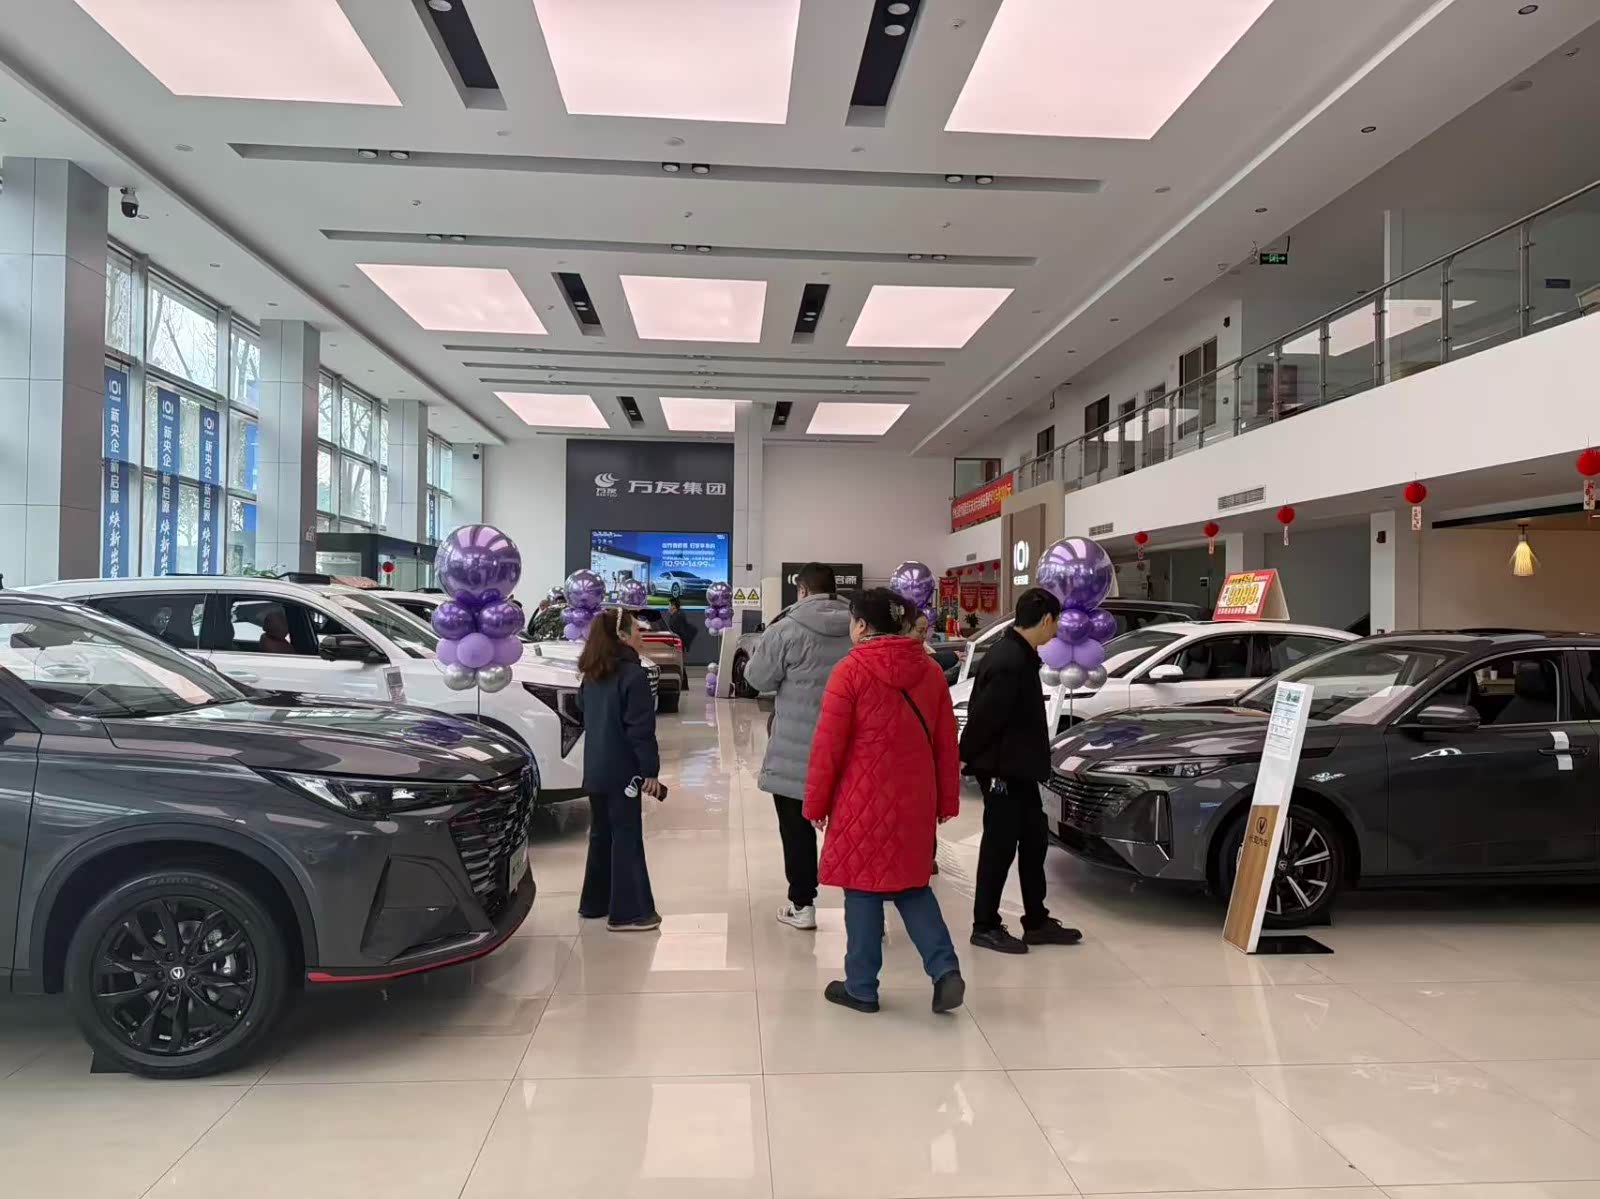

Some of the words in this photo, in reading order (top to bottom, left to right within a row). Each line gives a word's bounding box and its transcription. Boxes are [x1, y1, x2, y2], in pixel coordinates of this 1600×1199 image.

[110, 407, 120, 453] 新央企
[163, 425, 172, 467] 新央企
[204, 440, 213, 480] 新央企
[627, 480, 727, 496] 万友集团
